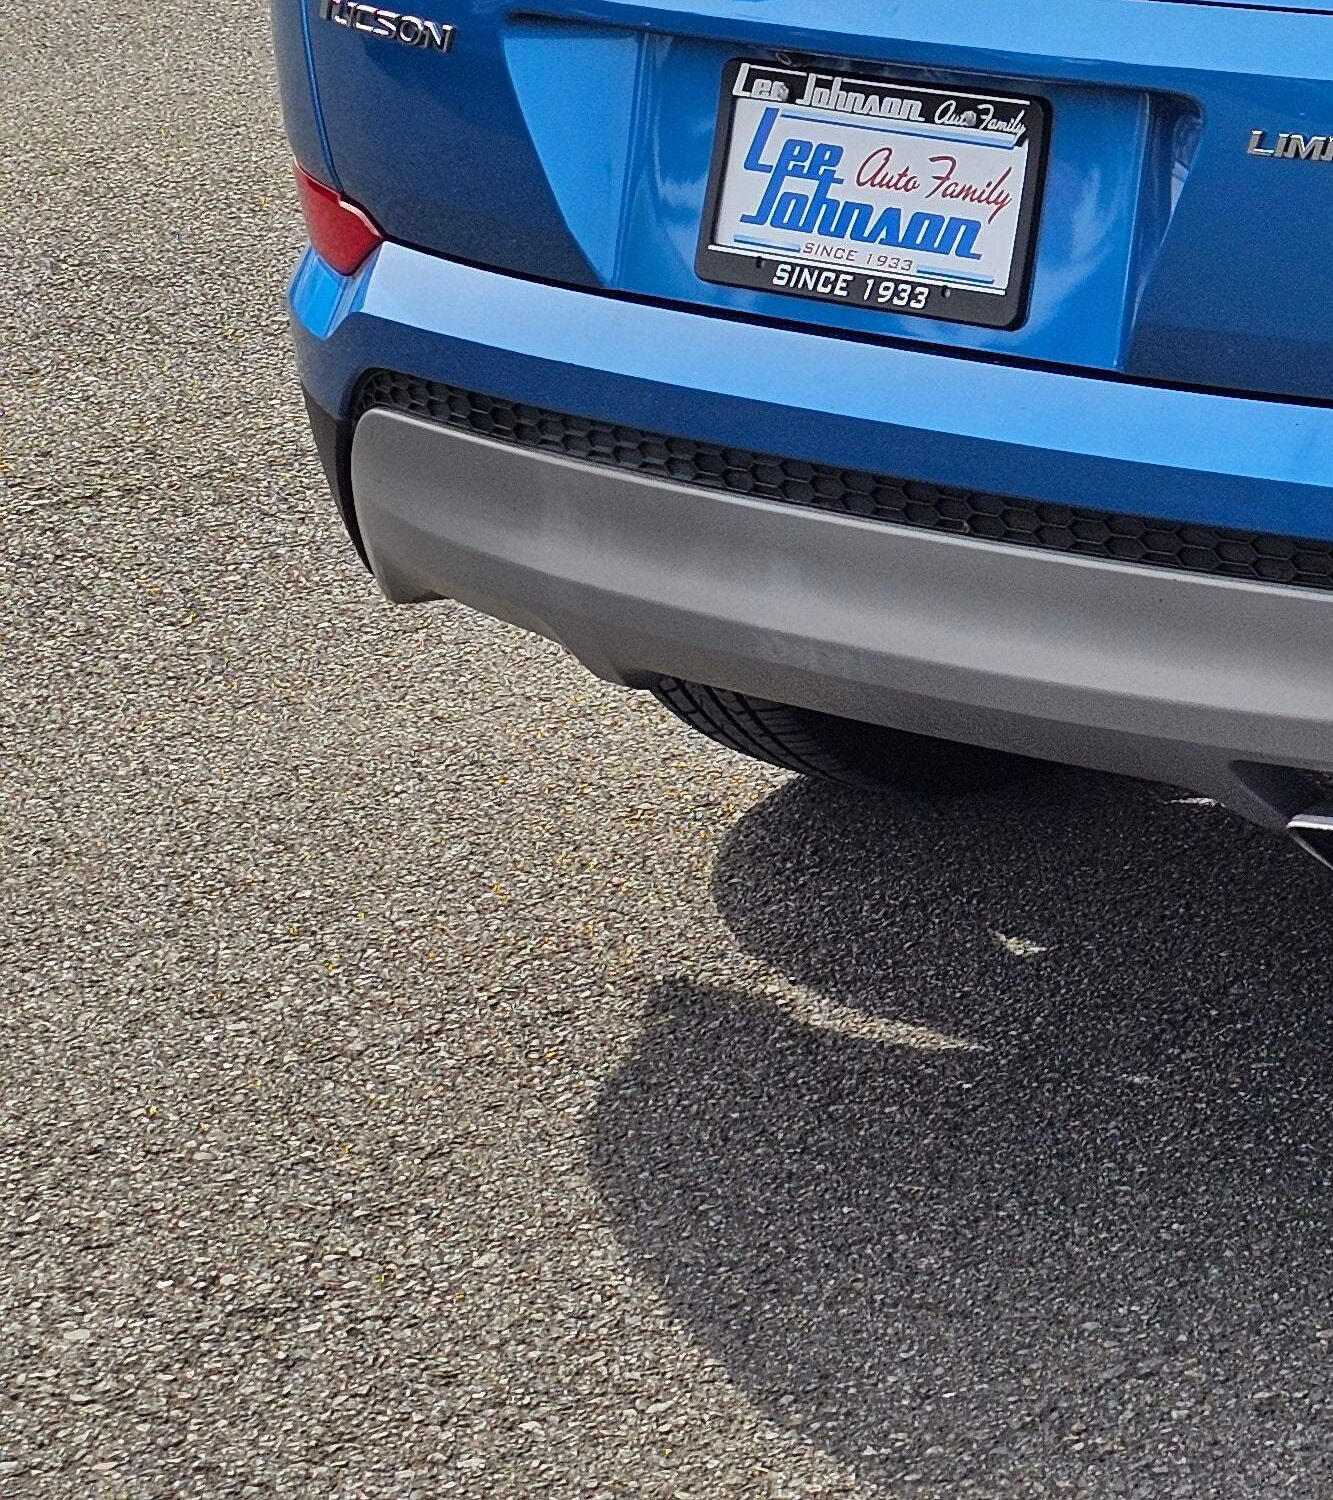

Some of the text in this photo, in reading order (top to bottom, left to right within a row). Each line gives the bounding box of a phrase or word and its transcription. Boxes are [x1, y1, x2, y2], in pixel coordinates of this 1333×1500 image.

[795, 72, 926, 122] Johnson
[934, 100, 977, 127] Aut
[977, 103, 1027, 142] Family
[744, 106, 1013, 224] Lee Auto Family
[740, 168, 983, 261] Johnson
[772, 263, 930, 310] SINCE 1933
[802, 242, 914, 272] SINCE 1933
